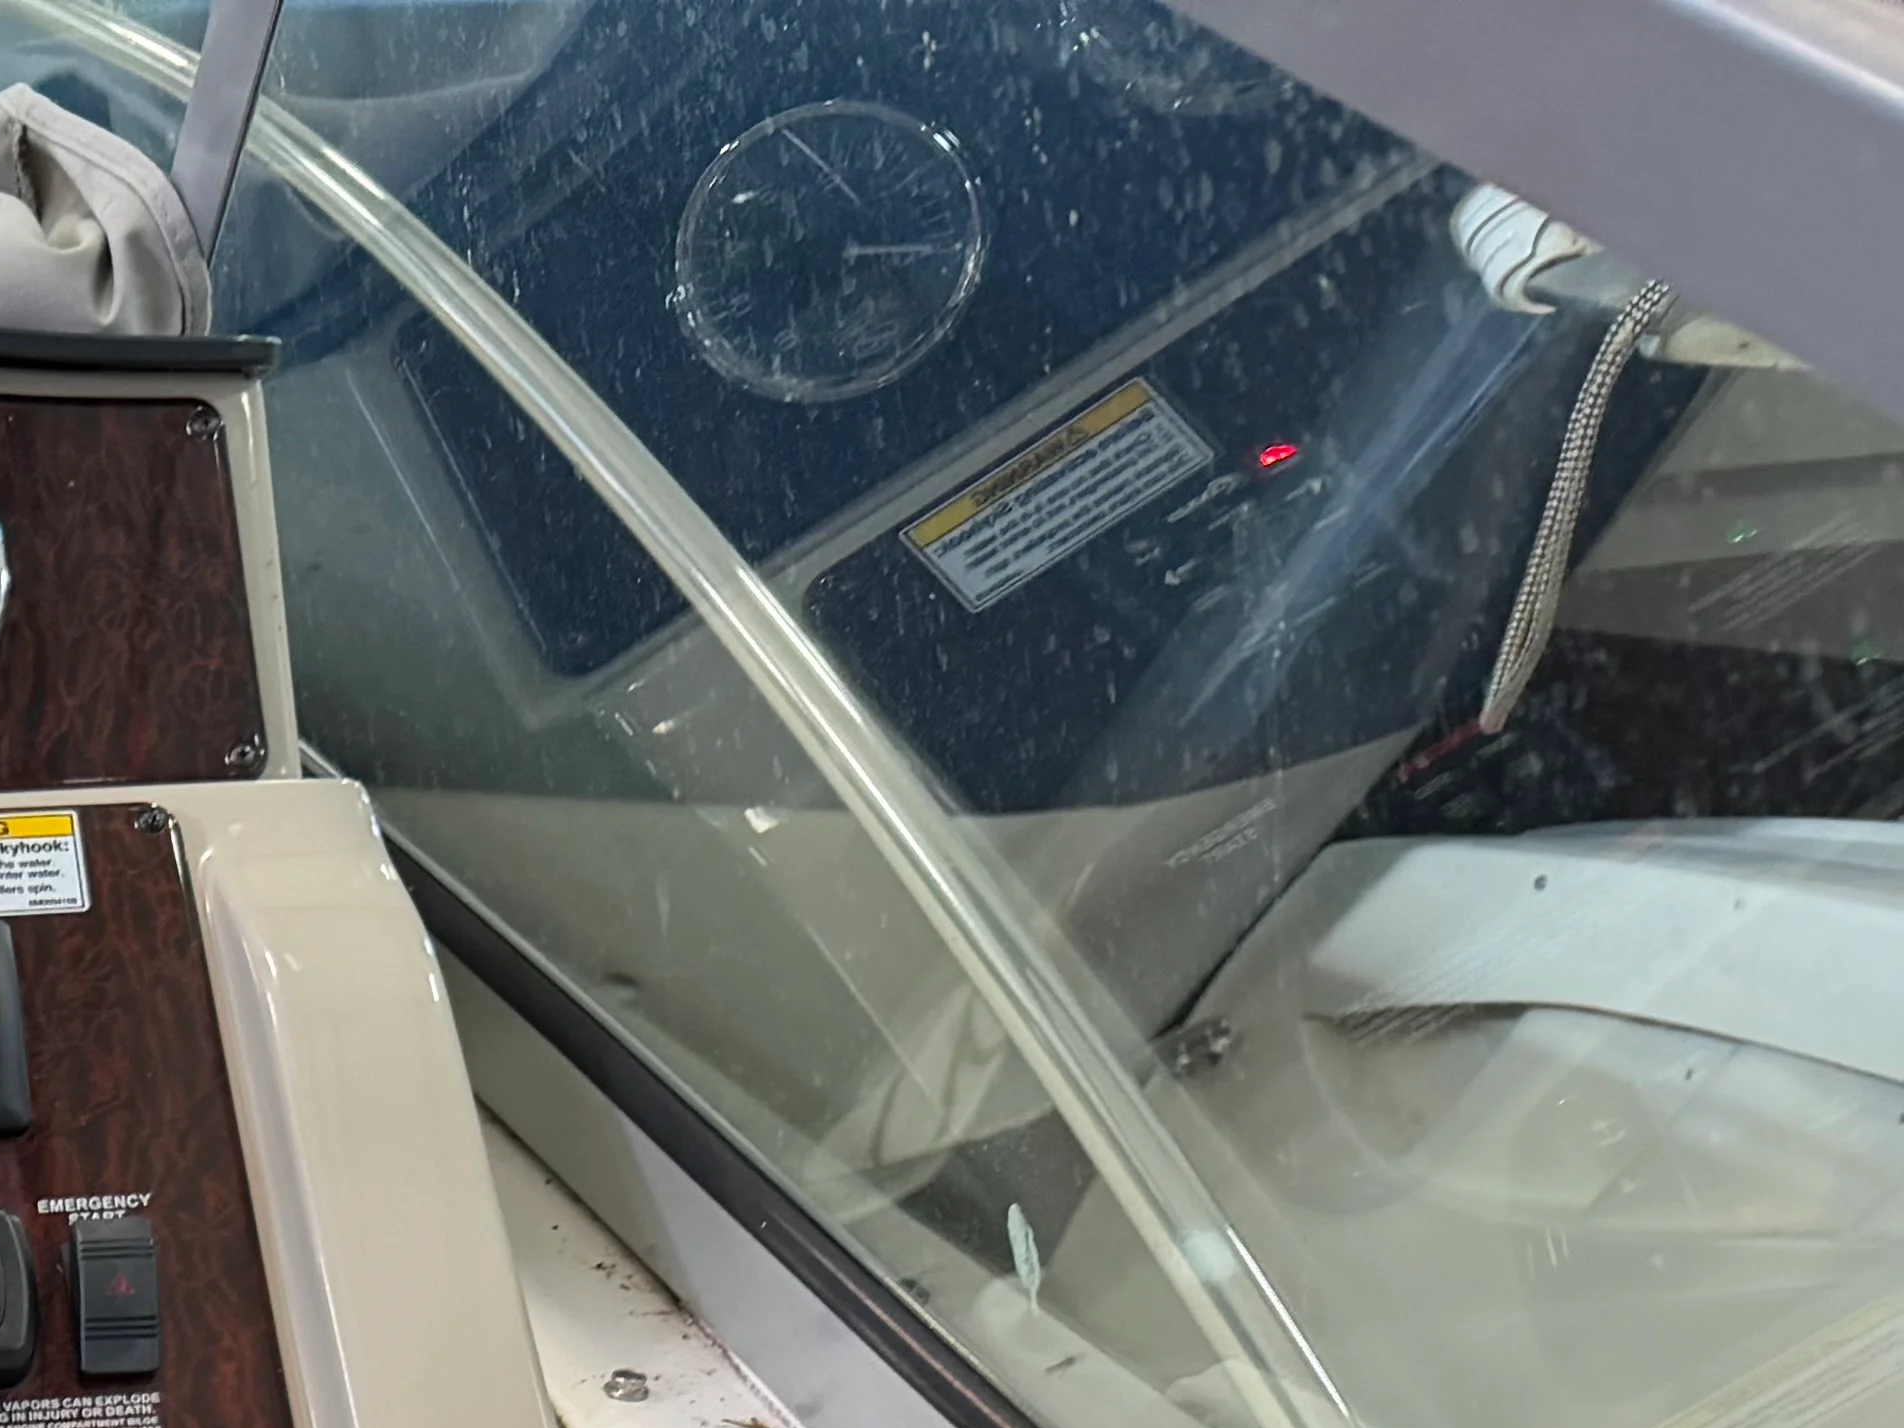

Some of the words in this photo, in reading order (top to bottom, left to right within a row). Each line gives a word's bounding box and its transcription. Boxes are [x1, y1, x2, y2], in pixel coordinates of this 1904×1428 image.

[28, 882, 56, 895] spin.
[37, 1193, 151, 1214] EMERGENCY
[3, 1398, 60, 1413] VAPORS
[63, 1396, 92, 1408] CAN
[95, 1392, 160, 1406] EXPLODE
[12, 1412, 26, 1424] IN
[28, 1408, 79, 1422] INJURY
[82, 1406, 102, 1418] OR
[106, 1404, 156, 1417] DEATH.
